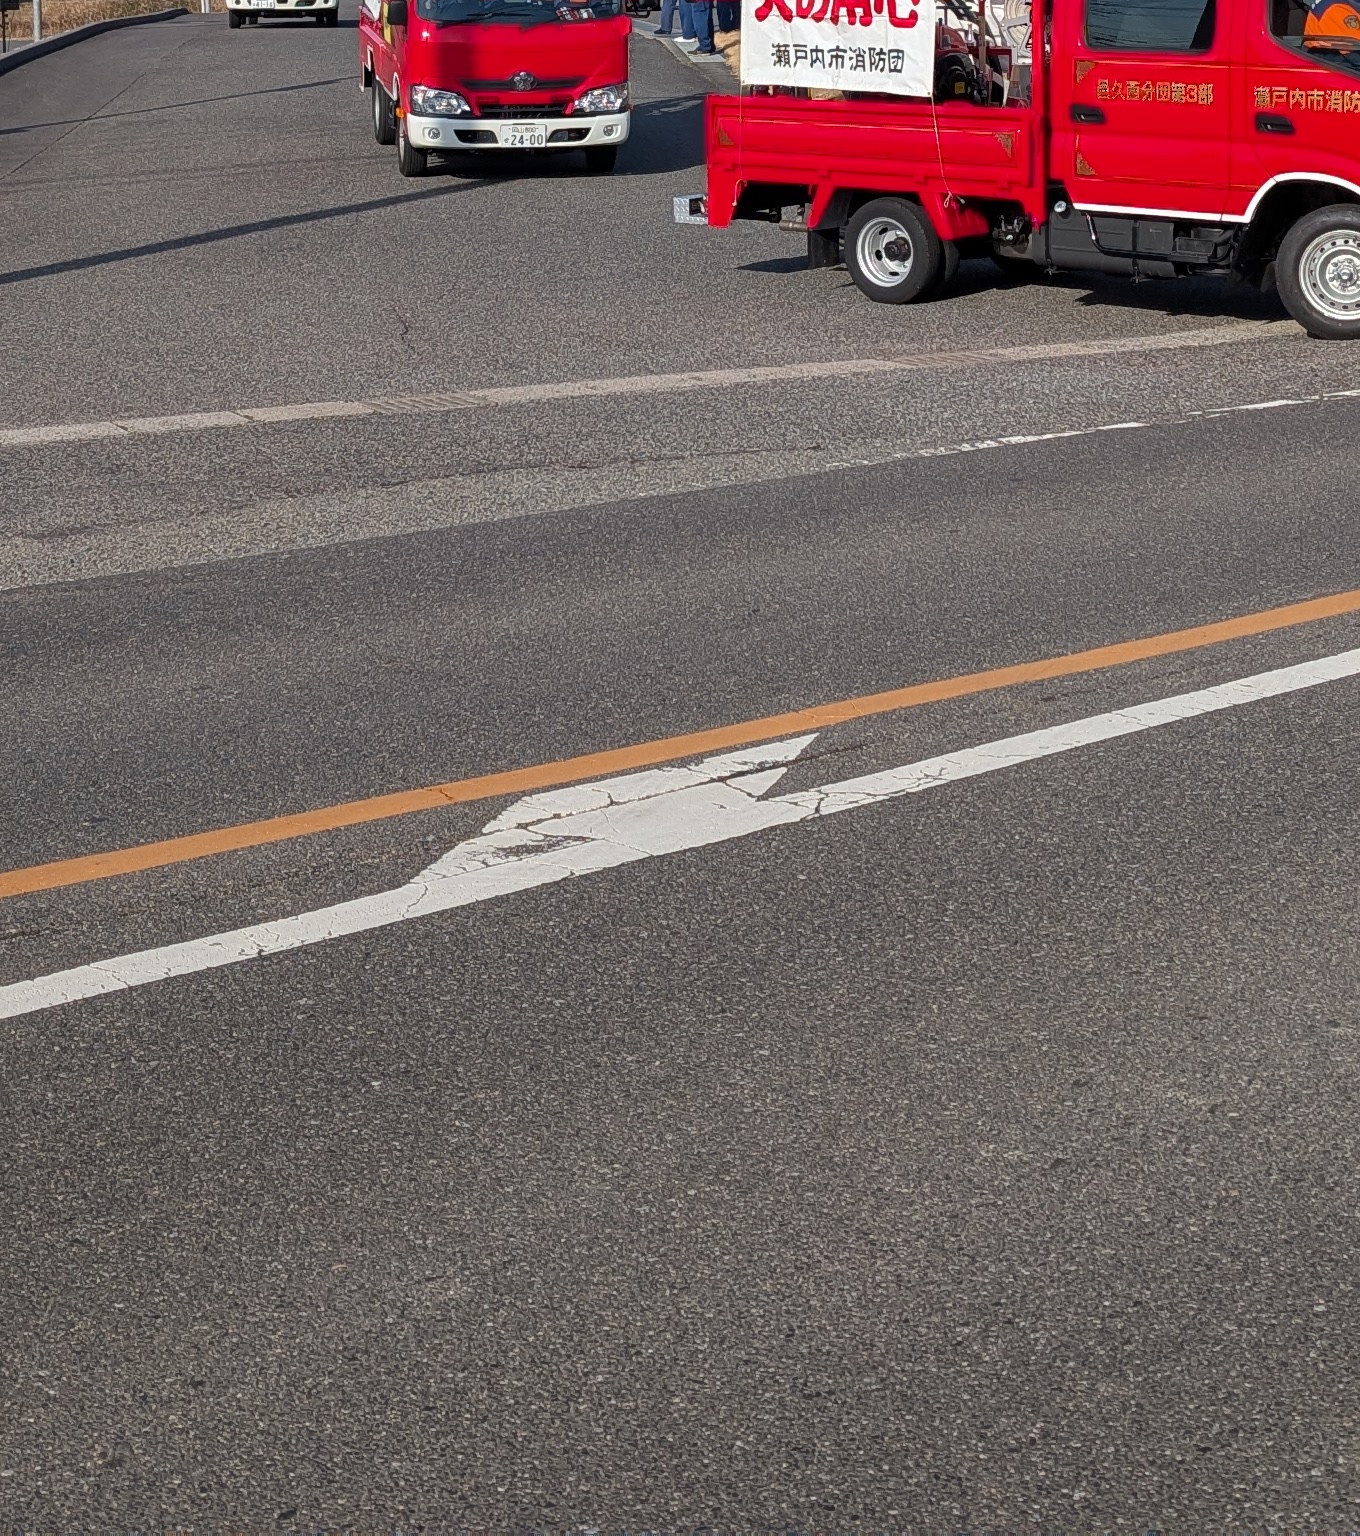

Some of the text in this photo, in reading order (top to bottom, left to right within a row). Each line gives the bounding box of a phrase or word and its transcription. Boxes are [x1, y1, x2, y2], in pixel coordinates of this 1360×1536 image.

[771, 42, 905, 73] 瀬戸内市消防団
[510, 133, 544, 146] 24-00
